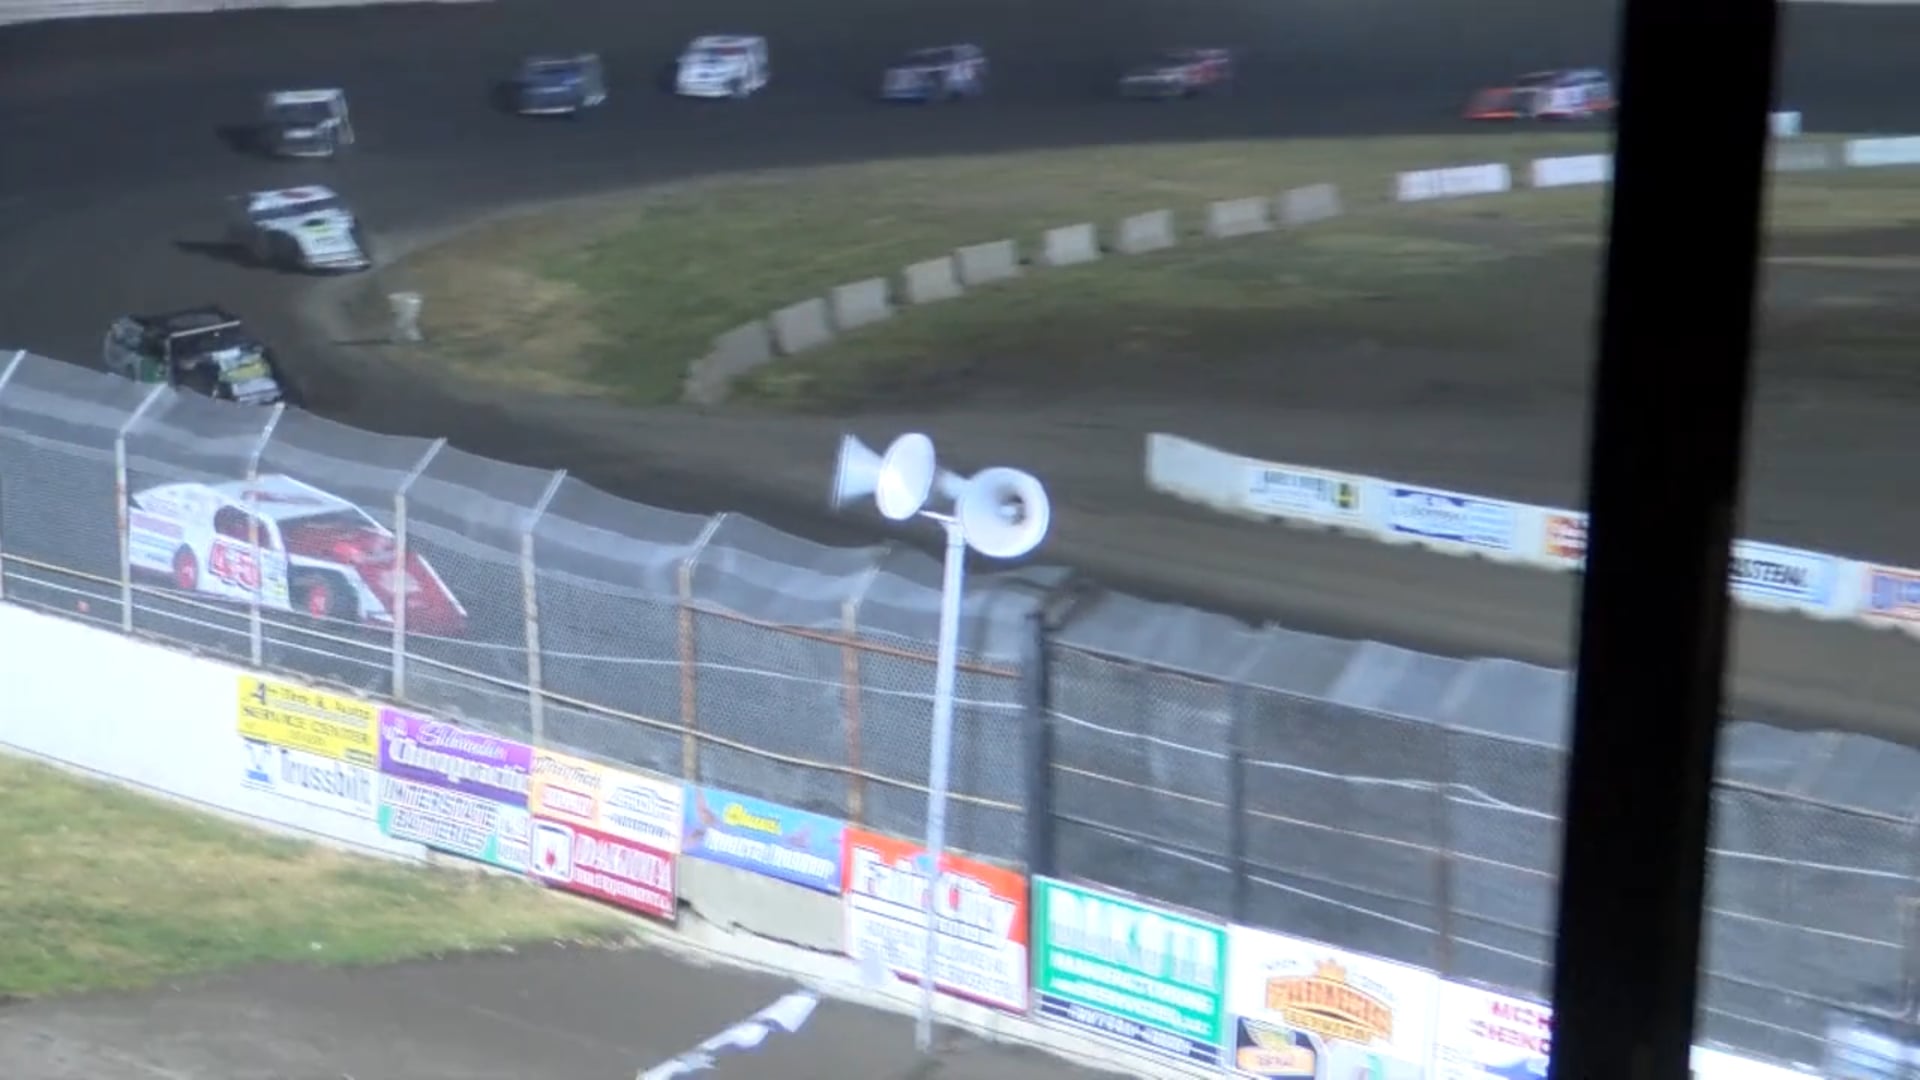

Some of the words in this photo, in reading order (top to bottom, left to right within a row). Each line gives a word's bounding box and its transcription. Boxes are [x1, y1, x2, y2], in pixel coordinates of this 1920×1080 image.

[243, 703, 306, 729] SERVICE
[311, 718, 368, 744] CENTER
[382, 776, 497, 827] INTERSTATE
[394, 808, 487, 850] BATTERIES
[575, 831, 672, 890] DAKOTA
[935, 867, 1017, 946] City
